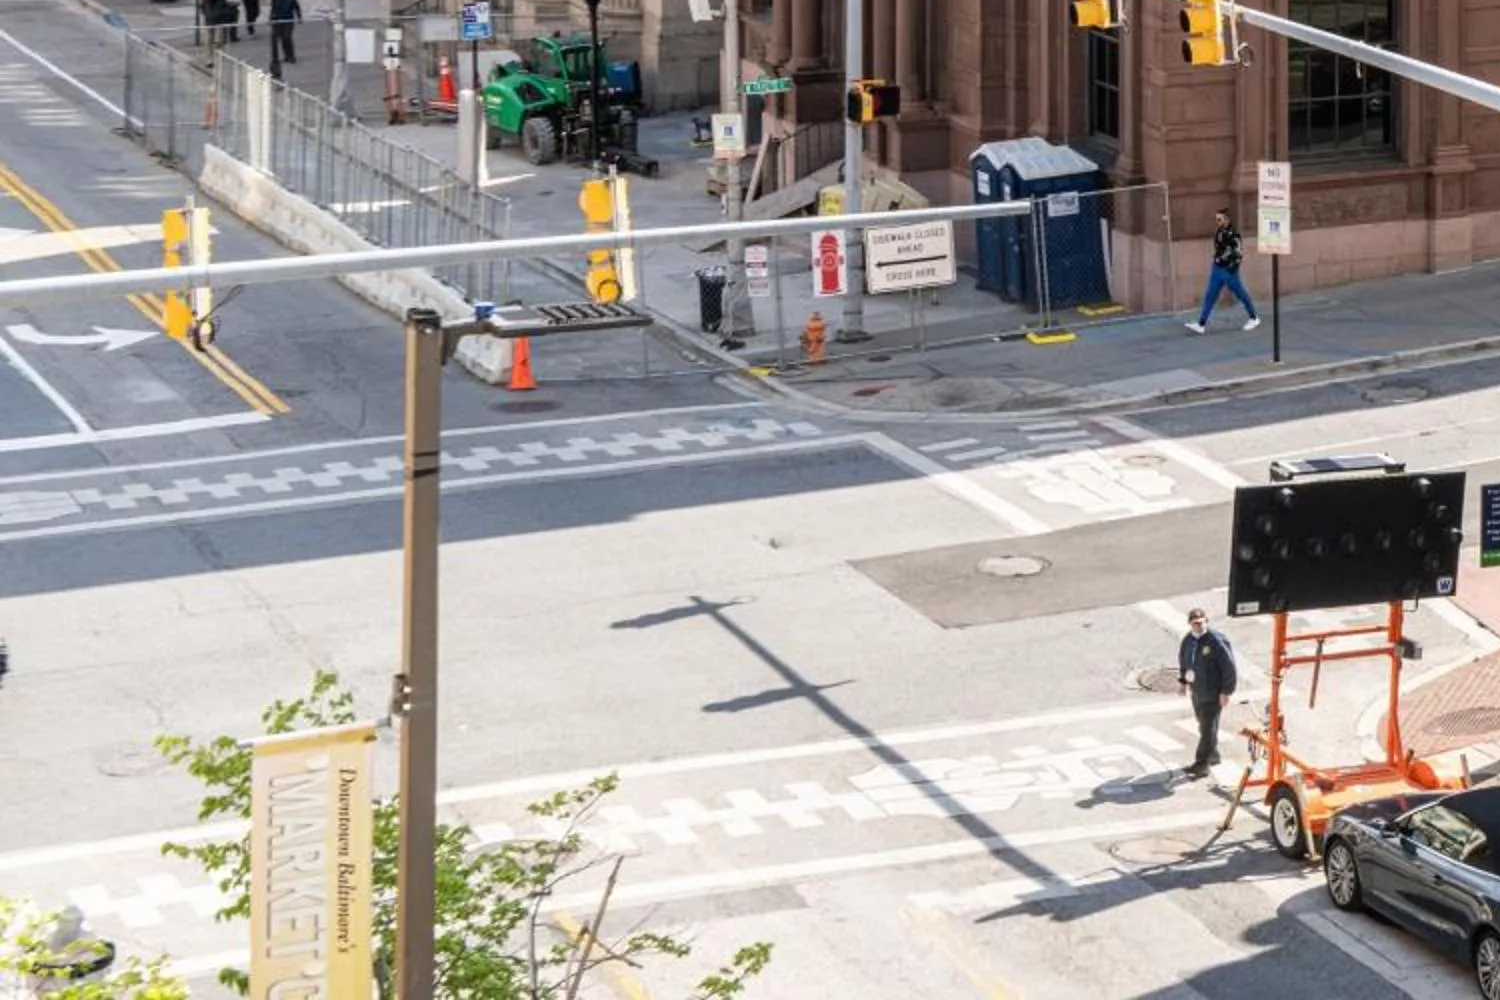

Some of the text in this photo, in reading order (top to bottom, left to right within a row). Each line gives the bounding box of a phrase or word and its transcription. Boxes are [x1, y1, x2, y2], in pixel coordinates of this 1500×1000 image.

[266, 769, 327, 959] MARKET
[338, 768, 358, 954] Downtown Baltimore's
